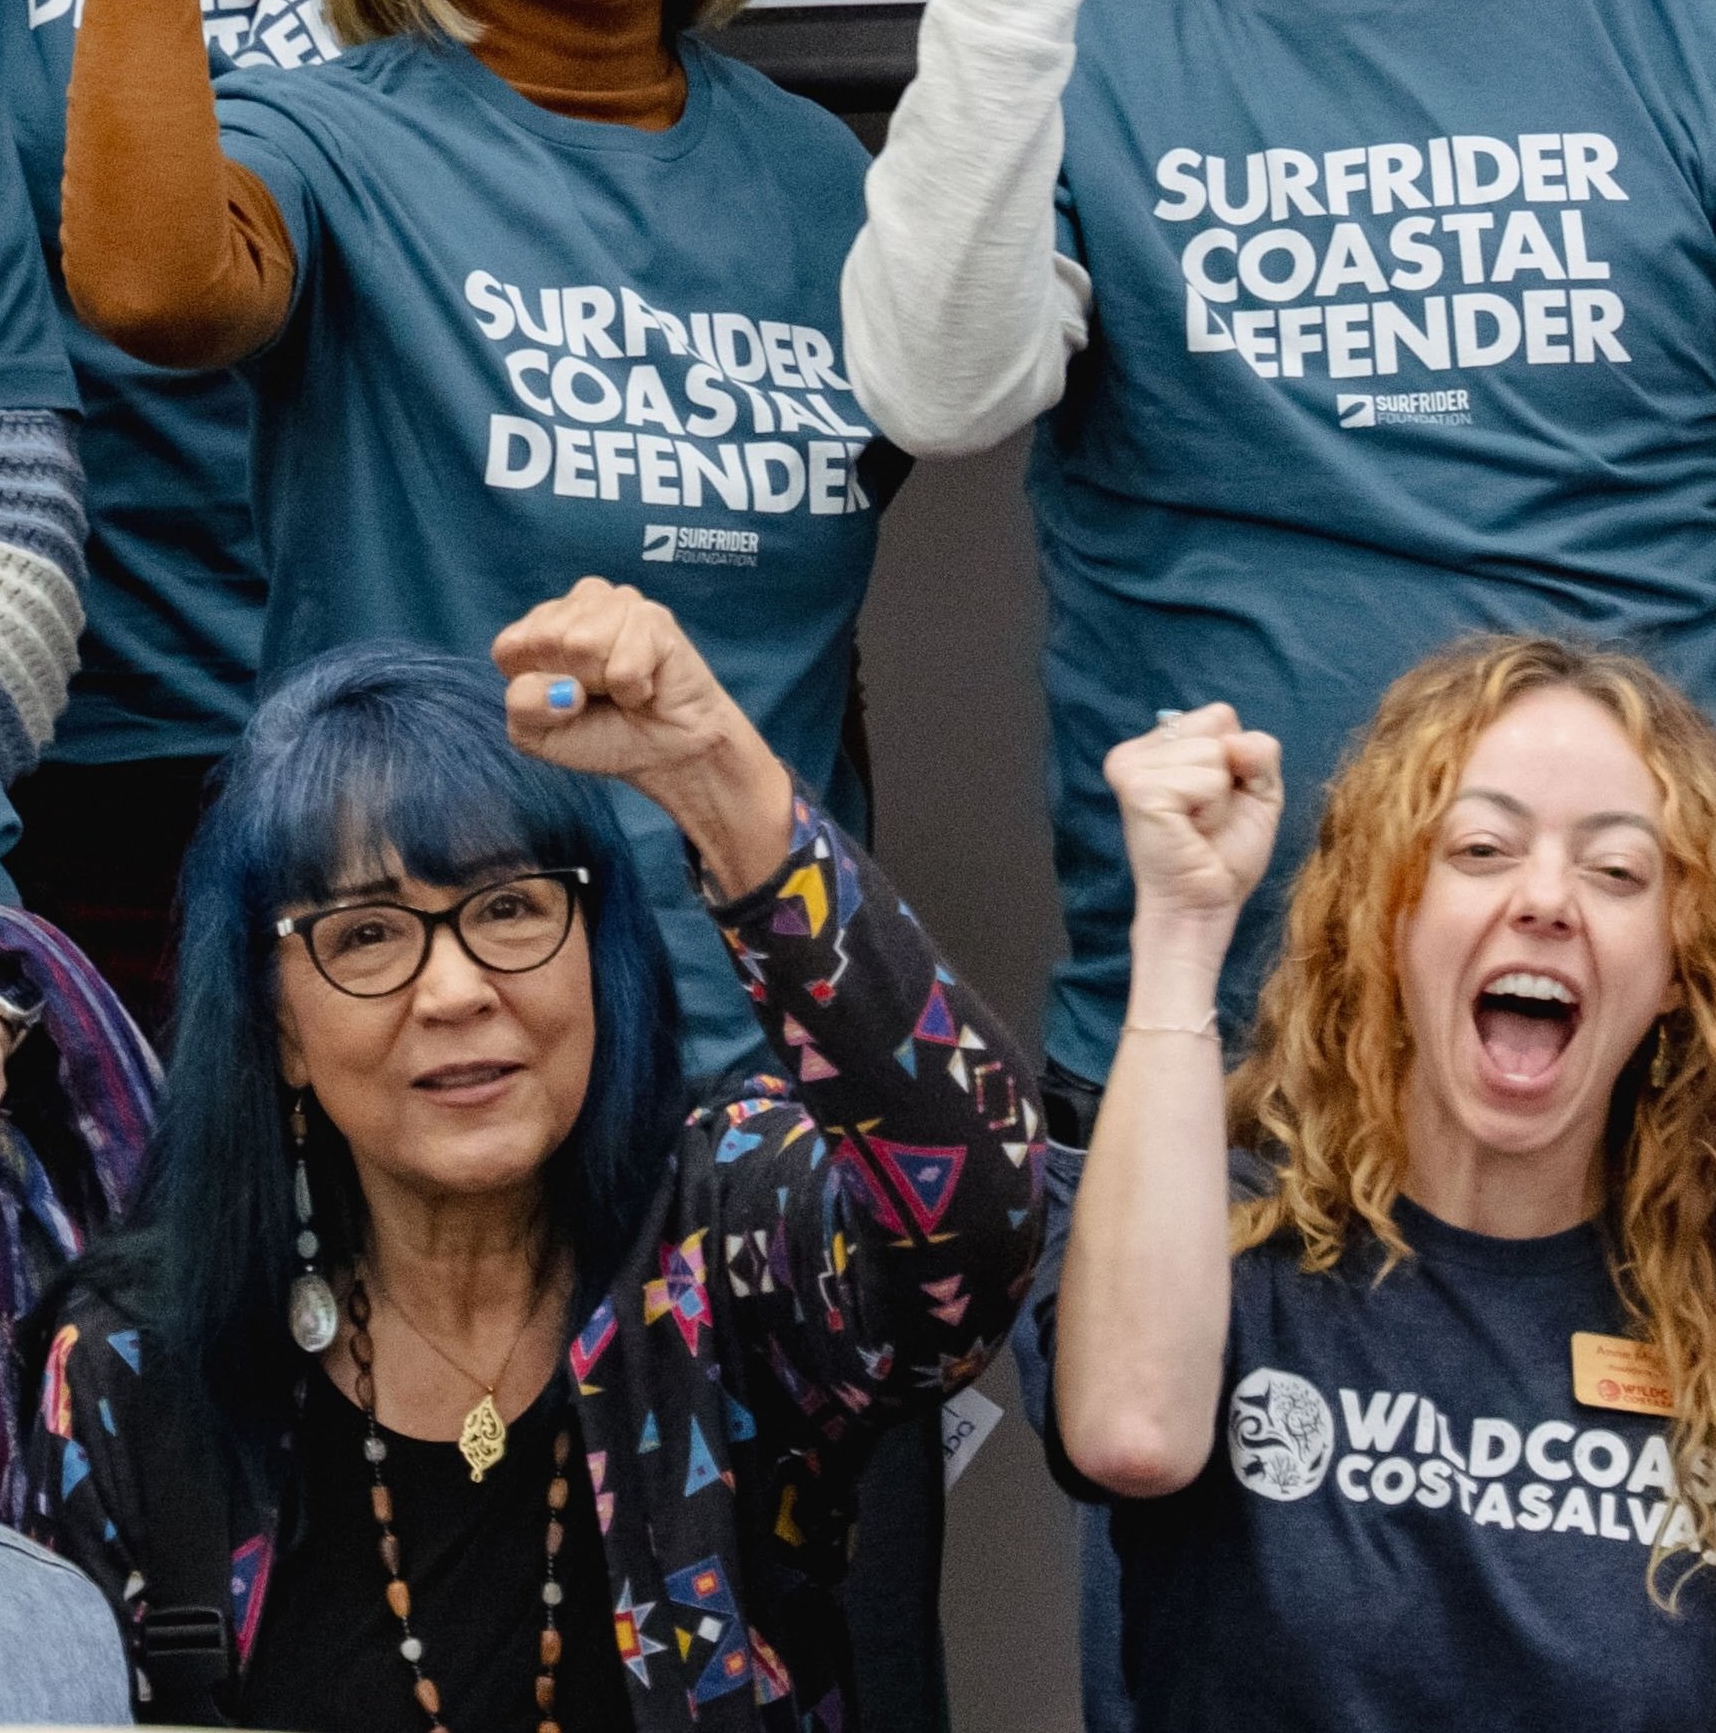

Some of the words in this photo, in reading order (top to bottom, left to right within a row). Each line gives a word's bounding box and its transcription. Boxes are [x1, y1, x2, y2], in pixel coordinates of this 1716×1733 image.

[1154, 132, 1630, 225] SURFRIDER
[1181, 209, 1611, 303] COASTAL
[504, 348, 872, 438] COASTAL
[1374, 389, 1469, 414] SURFRIDER
[678, 527, 759, 553] SURFRIDER
